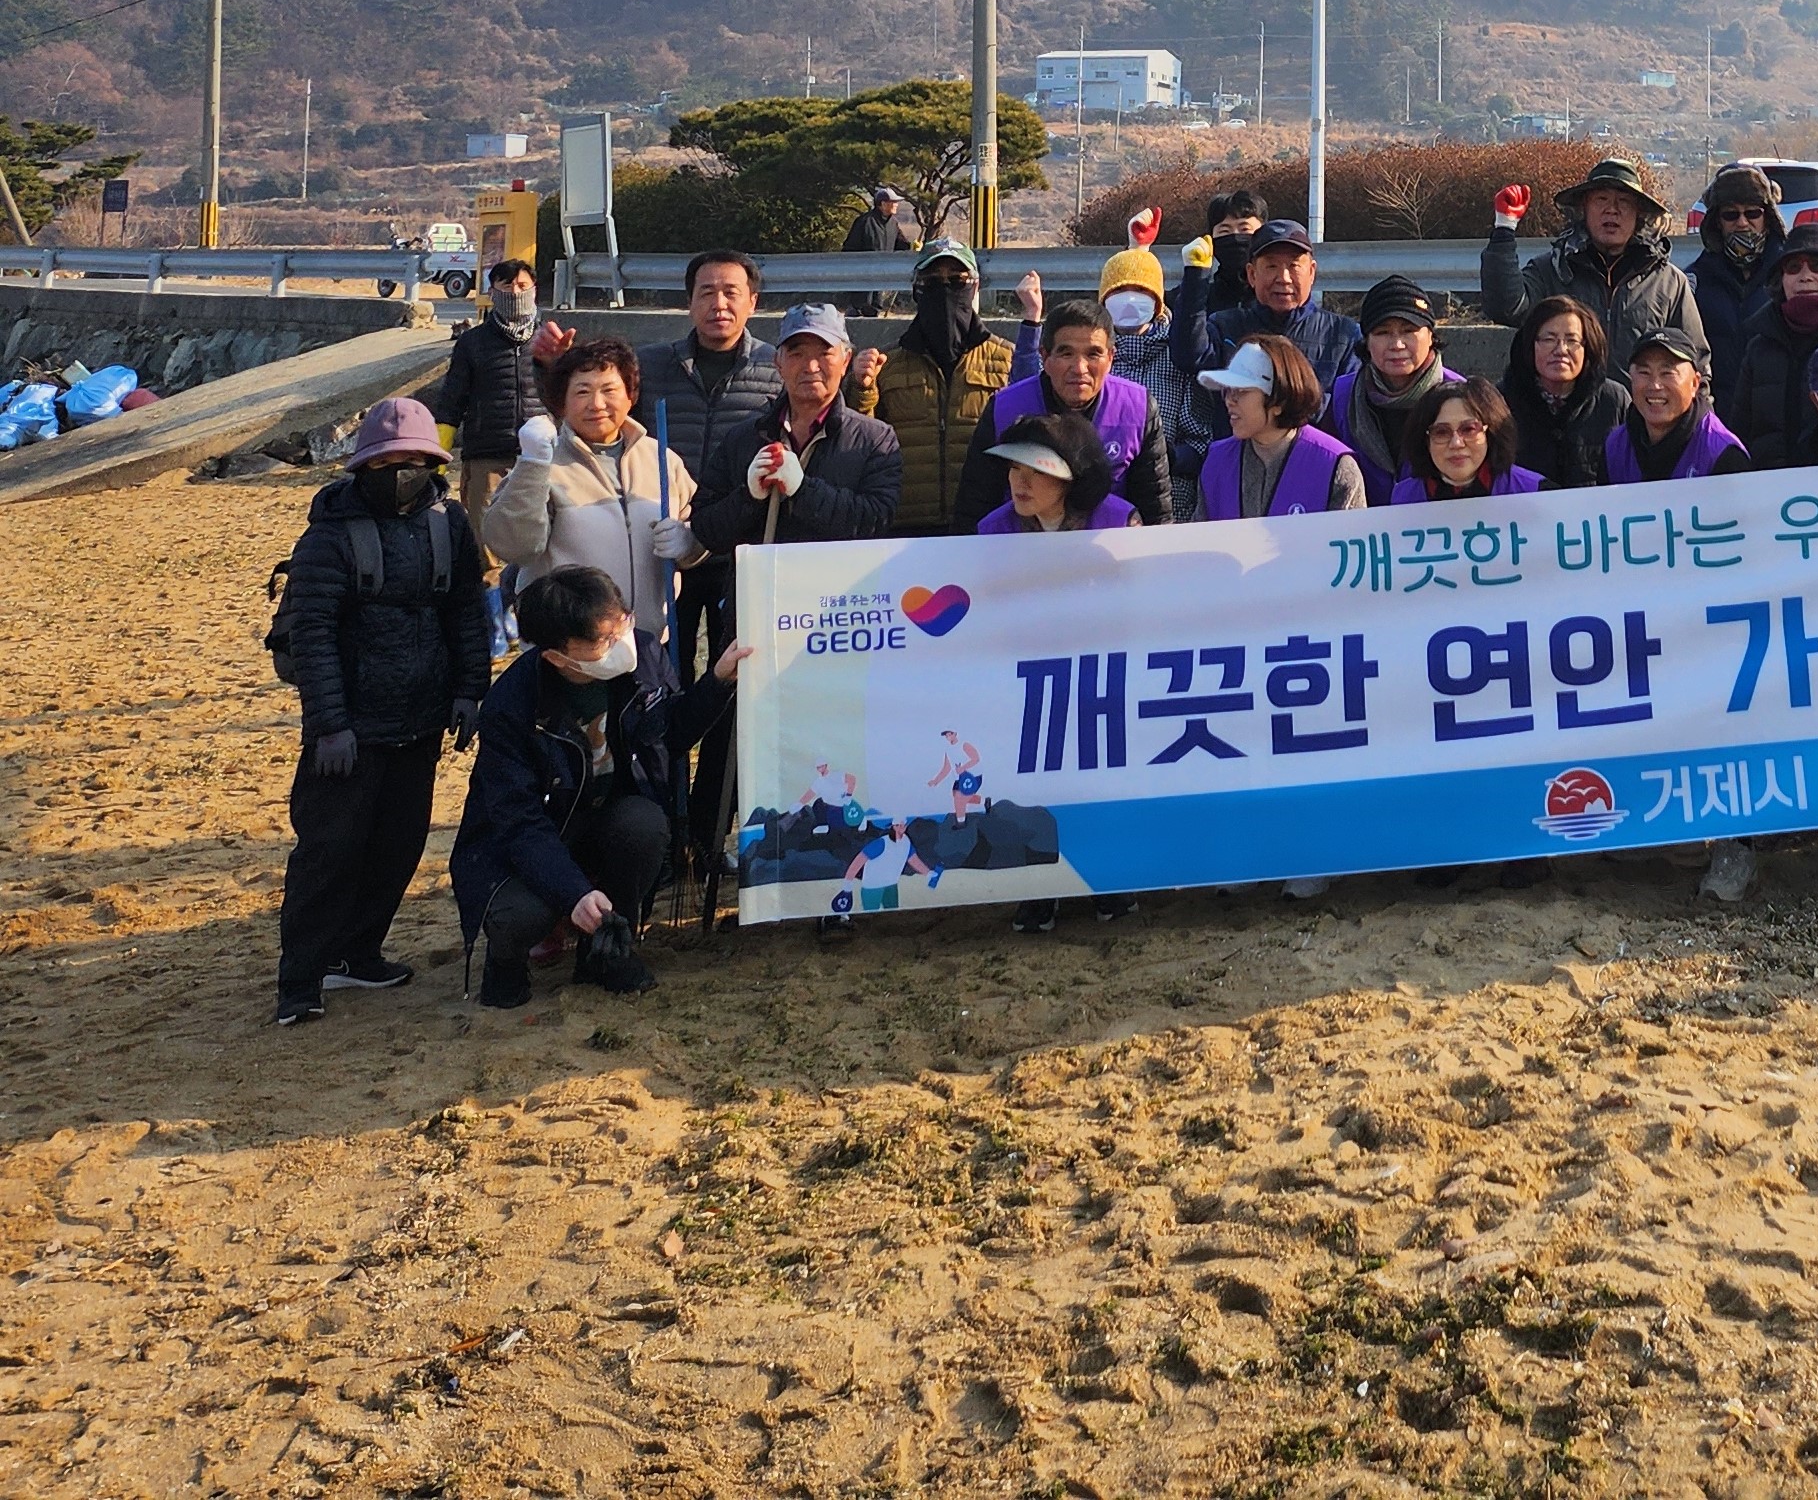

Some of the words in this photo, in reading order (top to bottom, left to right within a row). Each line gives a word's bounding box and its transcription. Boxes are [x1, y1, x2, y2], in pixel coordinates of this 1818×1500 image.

[1329, 521, 1527, 594] 깨끗한
[1557, 504, 1746, 574] 바다는
[778, 613, 814, 631] BIG
[819, 609, 895, 629] HEART
[849, 594, 870, 607] 주는
[871, 592, 891, 605] 거제
[806, 627, 907, 655] GEOJE
[1016, 633, 1379, 774] 깨끗한
[1426, 610, 1662, 742] 연안
[1640, 755, 1806, 824] 거제시
